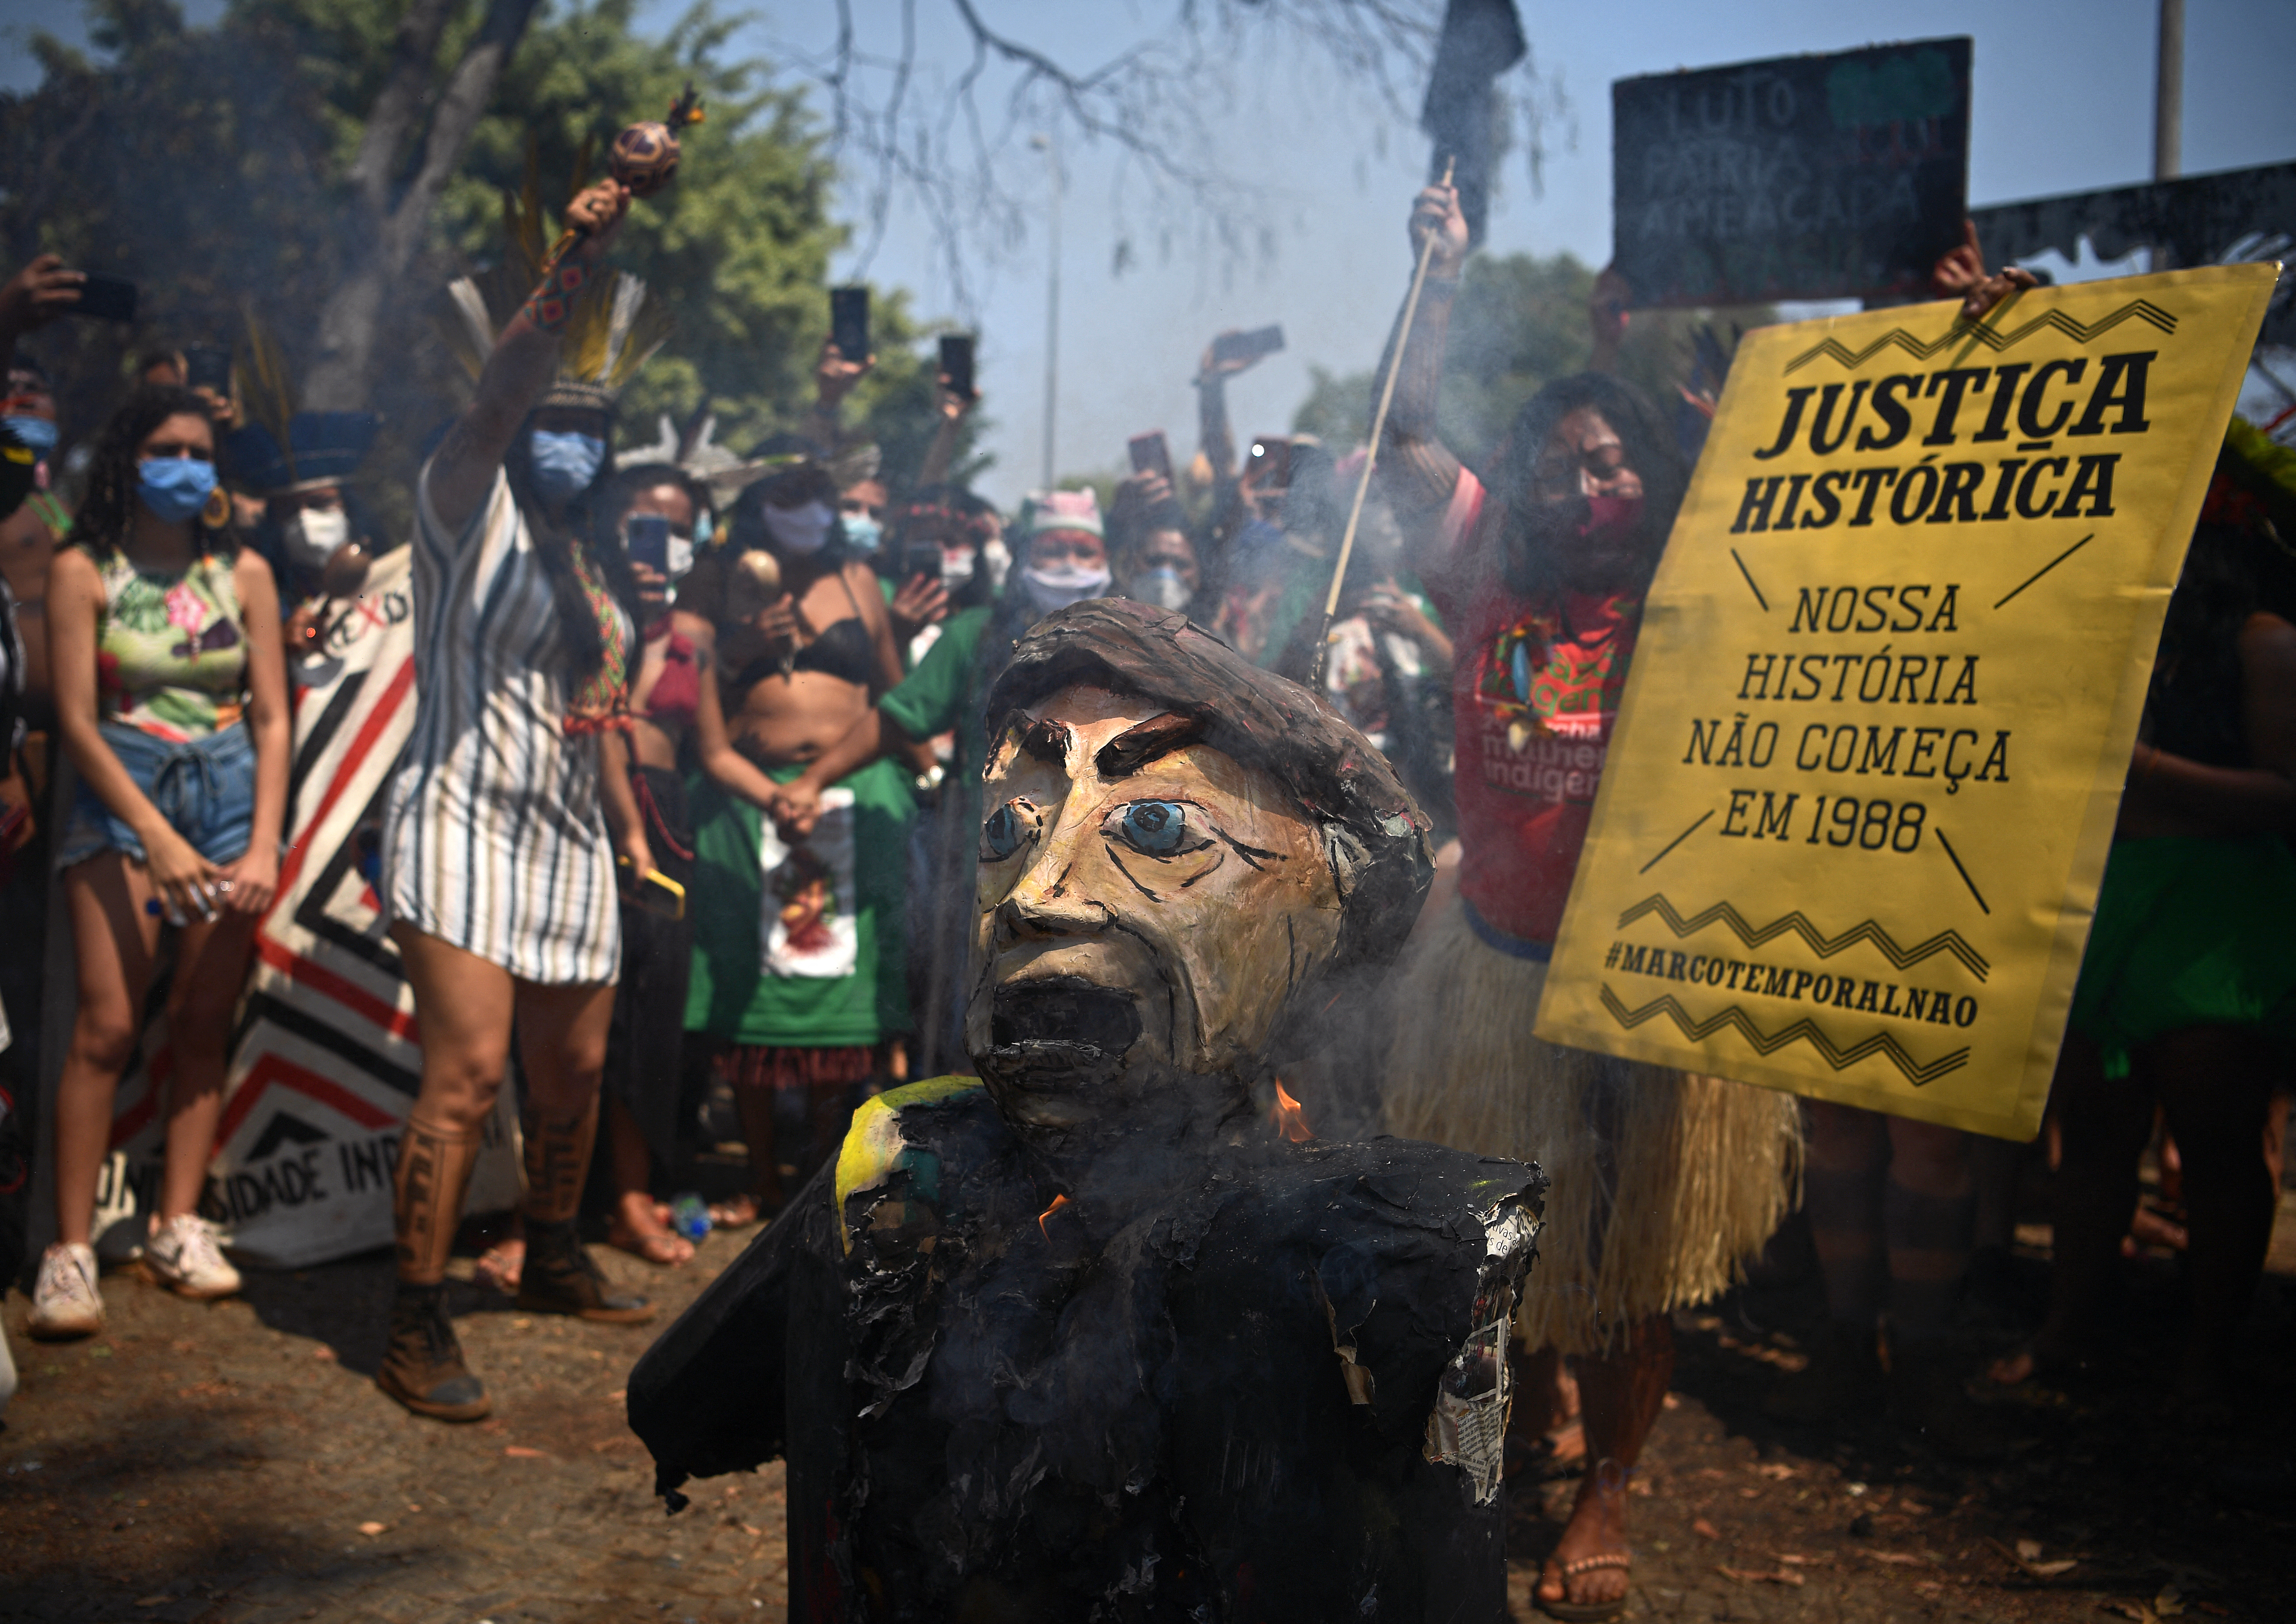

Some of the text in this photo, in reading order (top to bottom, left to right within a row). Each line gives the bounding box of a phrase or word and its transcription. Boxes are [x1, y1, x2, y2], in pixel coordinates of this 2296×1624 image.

[1754, 350, 2158, 459] JUSTIÇA
[1730, 453, 2122, 533] HISTÓRICA
[1789, 584, 1960, 633] NOSSA
[1738, 645, 1979, 705] HISTÓRIA
[1683, 712, 2011, 796] NÃO COMEÇA
[1720, 789, 1926, 853] EM 1988
[1606, 944, 1978, 1028] #MARCOTEMPORALNAO
[1496, 1239, 1508, 1254] de
